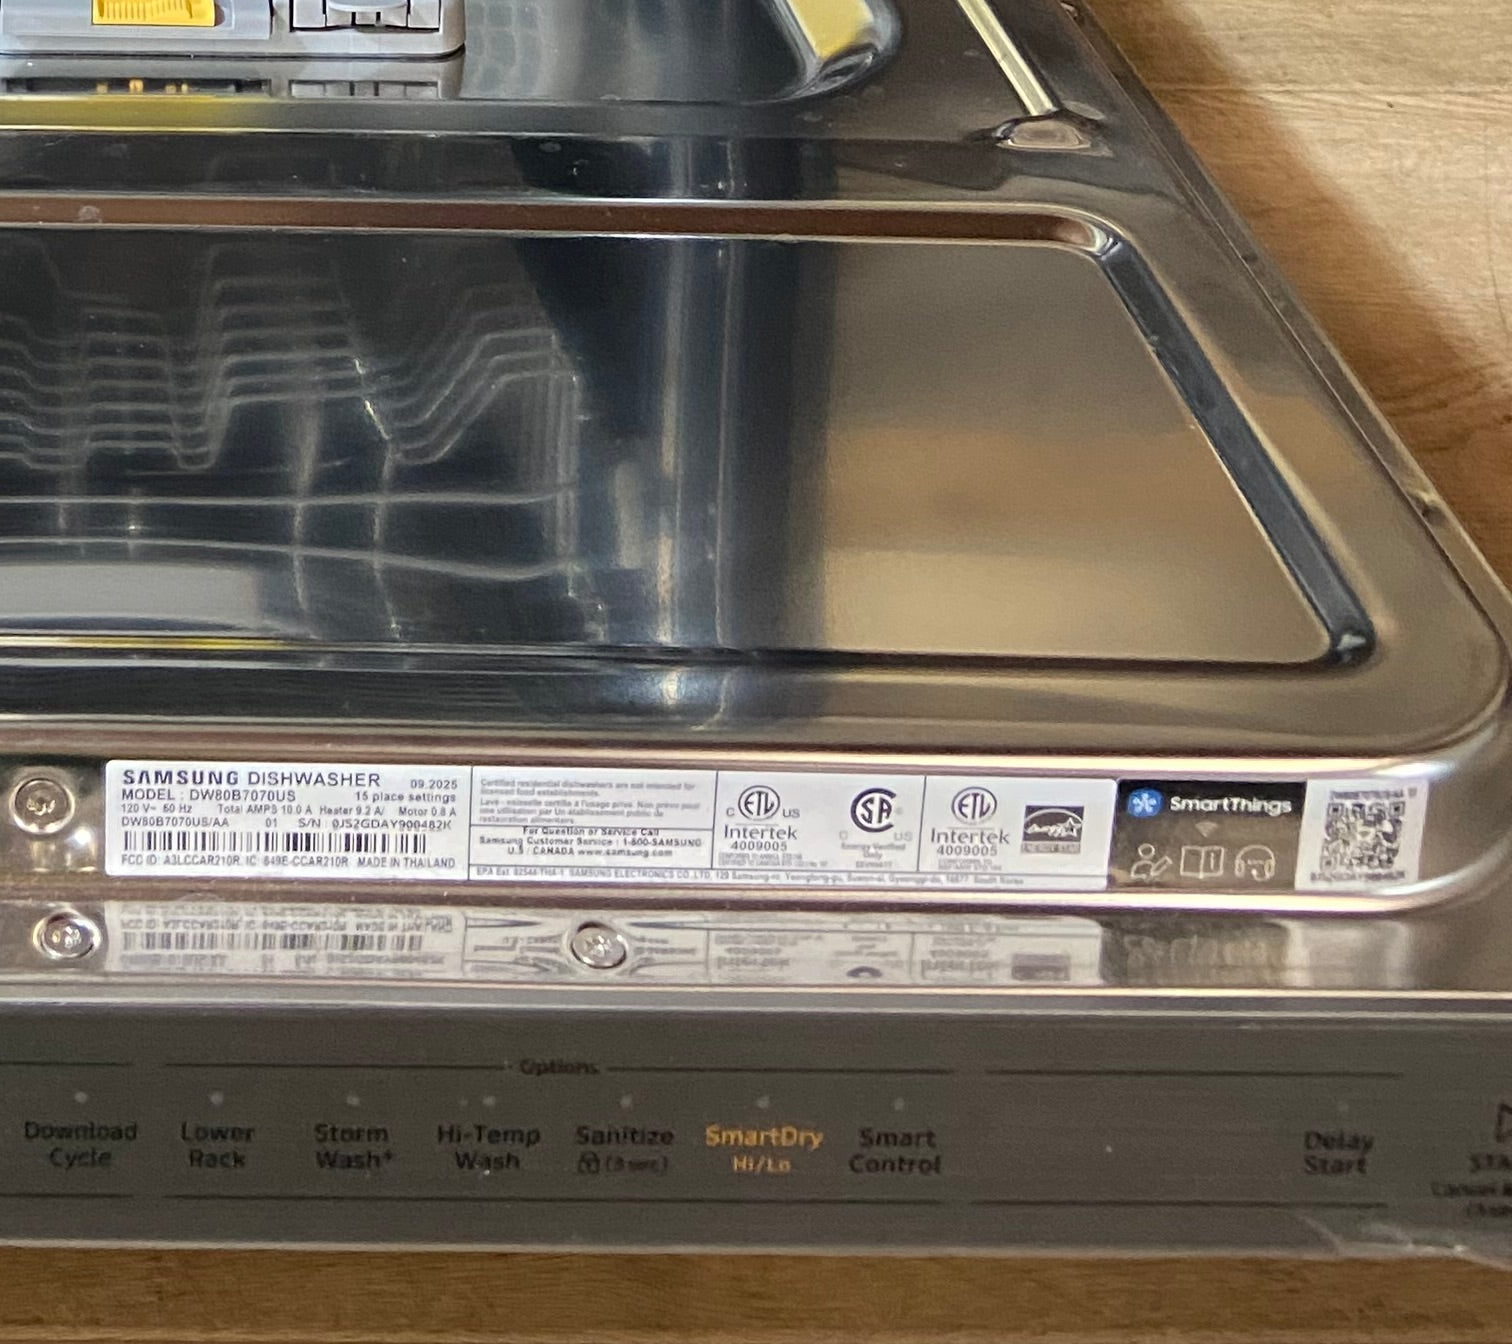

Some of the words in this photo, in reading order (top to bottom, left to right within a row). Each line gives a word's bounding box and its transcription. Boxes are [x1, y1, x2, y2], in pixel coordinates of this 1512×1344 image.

[123, 770, 238, 785] SAMSUNG
[248, 771, 381, 787] DISHWASHER
[410, 779, 458, 790] 09.2025
[122, 788, 176, 800] MODEL
[190, 790, 296, 802] DW80B7070US
[356, 791, 368, 801] 15
[372, 792, 404, 803] place
[408, 792, 456, 804] settings
[122, 804, 138, 813] 120
[179, 804, 193, 814] Hz
[218, 804, 243, 814] Total
[246, 805, 278, 814] AMPS
[282, 806, 302, 814] 10.0
[306, 806, 312, 814] A
[320, 806, 352, 816] Heater
[356, 806, 371, 816] 9.2
[399, 806, 428, 816] Motor
[431, 807, 446, 816] 0.8
[449, 808, 457, 816] A
[782, 808, 800, 818] US
[1170, 796, 1292, 816] SmartThings
[122, 816, 230, 827] DW80B7070US/AA
[266, 818, 278, 828] 01
[299, 818, 321, 828] S/N
[522, 826, 538, 834] For
[542, 826, 585, 835] Question
[588, 828, 597, 836] or
[601, 828, 637, 836] Service
[640, 828, 660, 836] Call
[724, 824, 798, 840] Intertek
[931, 828, 1010, 844] Intertek
[480, 836, 523, 846] Samsung
[526, 837, 574, 846] Customer
[576, 838, 612, 846] Service
[623, 838, 702, 847] 1-800-SAMSUNG
[730, 840, 788, 852] 4009005
[533, 847, 575, 856] CANADA
[578, 848, 672, 858] www.samsung.com
[937, 844, 998, 856] 4009005
[122, 854, 144, 866] FCC
[358, 857, 386, 868] MADE
[390, 857, 400, 868] IN
[403, 858, 456, 868] THAILAND
[569, 869, 612, 878] SAMSUNG
[614, 870, 674, 879] ELECTRONICS
[519, 1059, 600, 1078] Options
[24, 1120, 138, 1142] Download
[180, 1122, 256, 1144] Lower
[314, 1124, 389, 1144] Storm
[436, 1125, 541, 1149] Hi-Temp
[576, 1125, 675, 1148] Sanitize
[705, 1124, 825, 1150] SmartDry
[858, 1126, 938, 1149] Smart
[1304, 1130, 1374, 1154] Delay
[49, 1147, 112, 1170] Cycle
[188, 1148, 246, 1170] Rack
[455, 1150, 521, 1172] Wash
[730, 1155, 792, 1174] Hi/Lo
[849, 1153, 942, 1176] Control
[1304, 1154, 1368, 1176] Start
